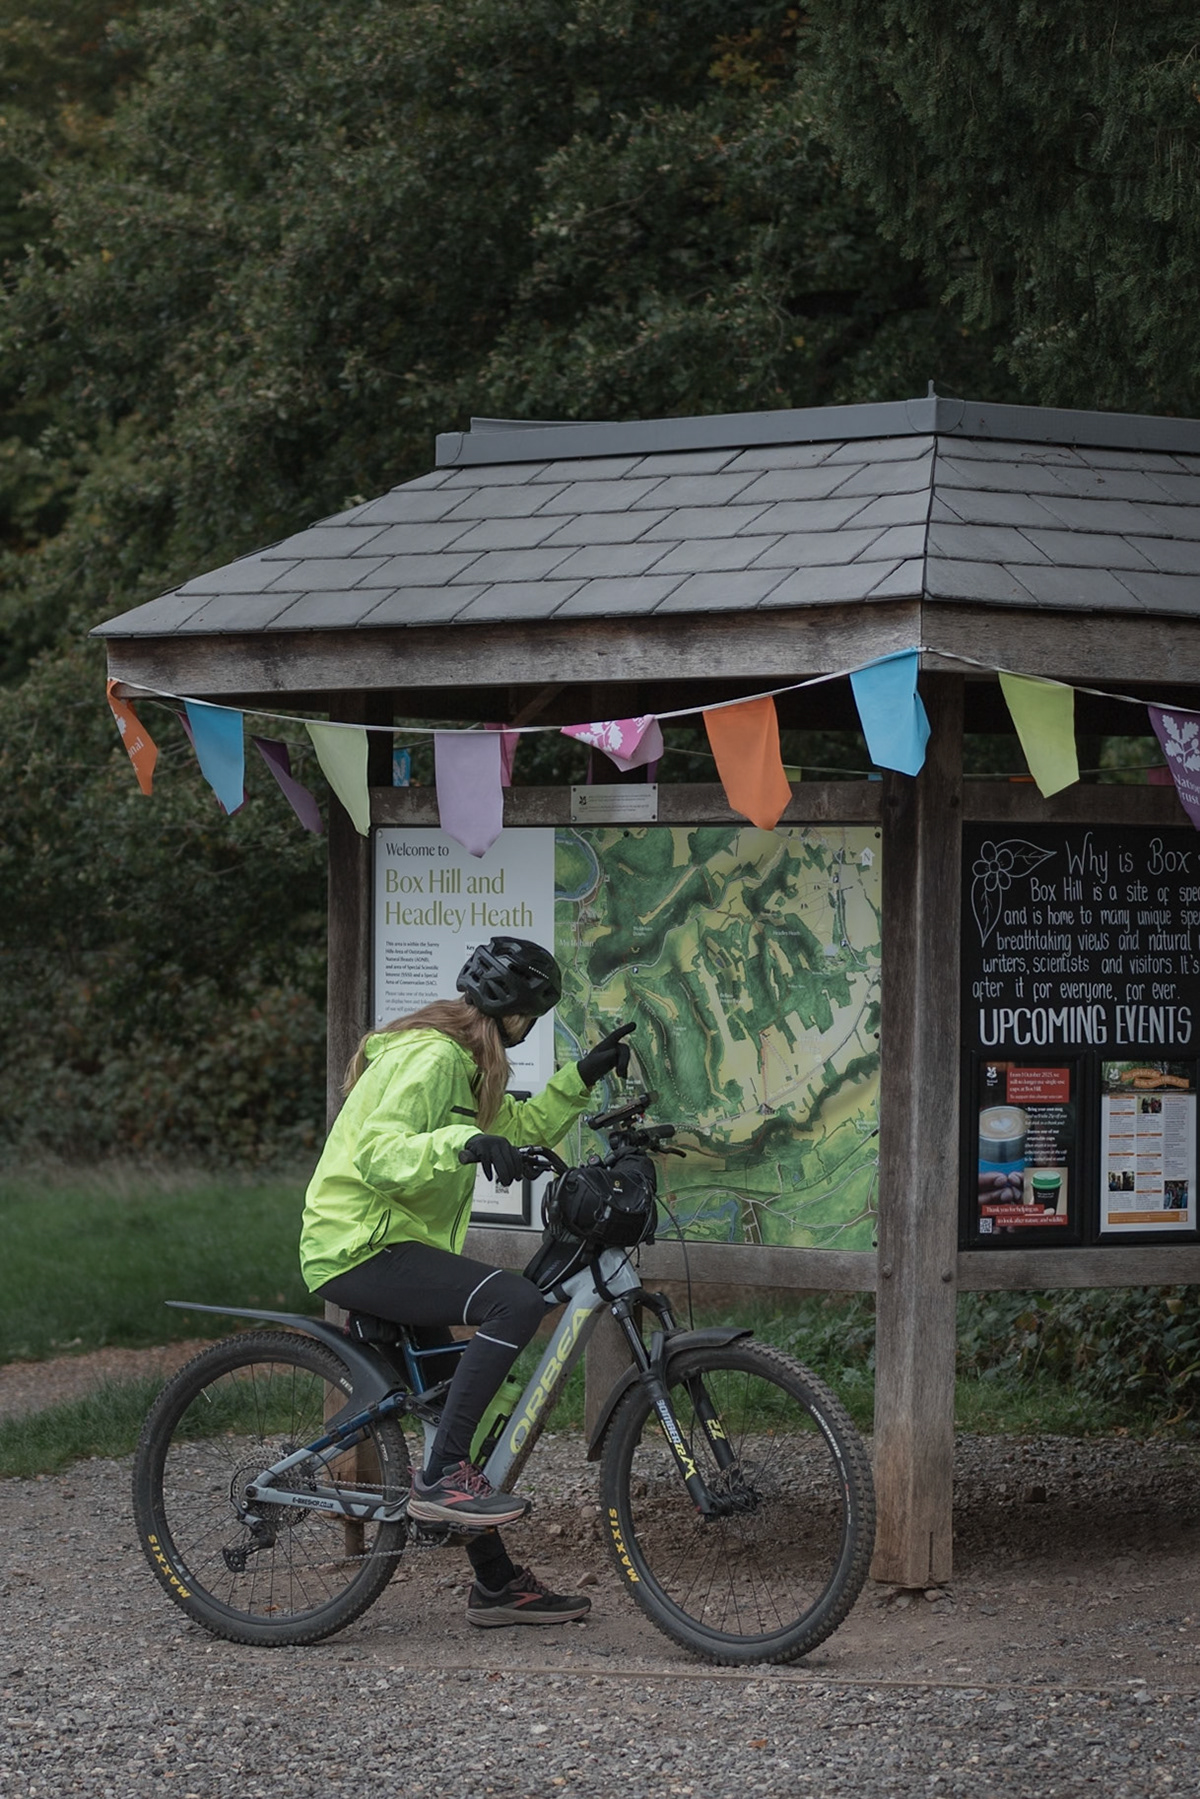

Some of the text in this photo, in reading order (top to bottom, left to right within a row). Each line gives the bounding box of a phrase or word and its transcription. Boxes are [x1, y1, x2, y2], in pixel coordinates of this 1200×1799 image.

[386, 843, 450, 856] Welcome to
[1065, 831, 1192, 884] Why is Box
[386, 868, 504, 894] Box Hill and
[1030, 877, 1056, 902] Box
[1064, 876, 1084, 902] Hill
[1092, 882, 1102, 902] is
[1109, 885, 1118, 900] a
[1126, 880, 1149, 902] site
[1158, 887, 1170, 906] of
[385, 900, 533, 934] Headley Heath
[1004, 905, 1200, 932] and is home to many unique spe
[996, 929, 1192, 958] breathtaking views and natural
[982, 953, 1200, 975] writers, scientists and visitors. It's
[972, 976, 1180, 1003] after it for everyone, for ever.
[980, 1004, 1192, 1045] UPCOMING EVENTS
[510, 1308, 594, 1454] ORBEA
[608, 1508, 640, 1582] MAXXIS
[148, 1534, 191, 1598] MAXXIS
